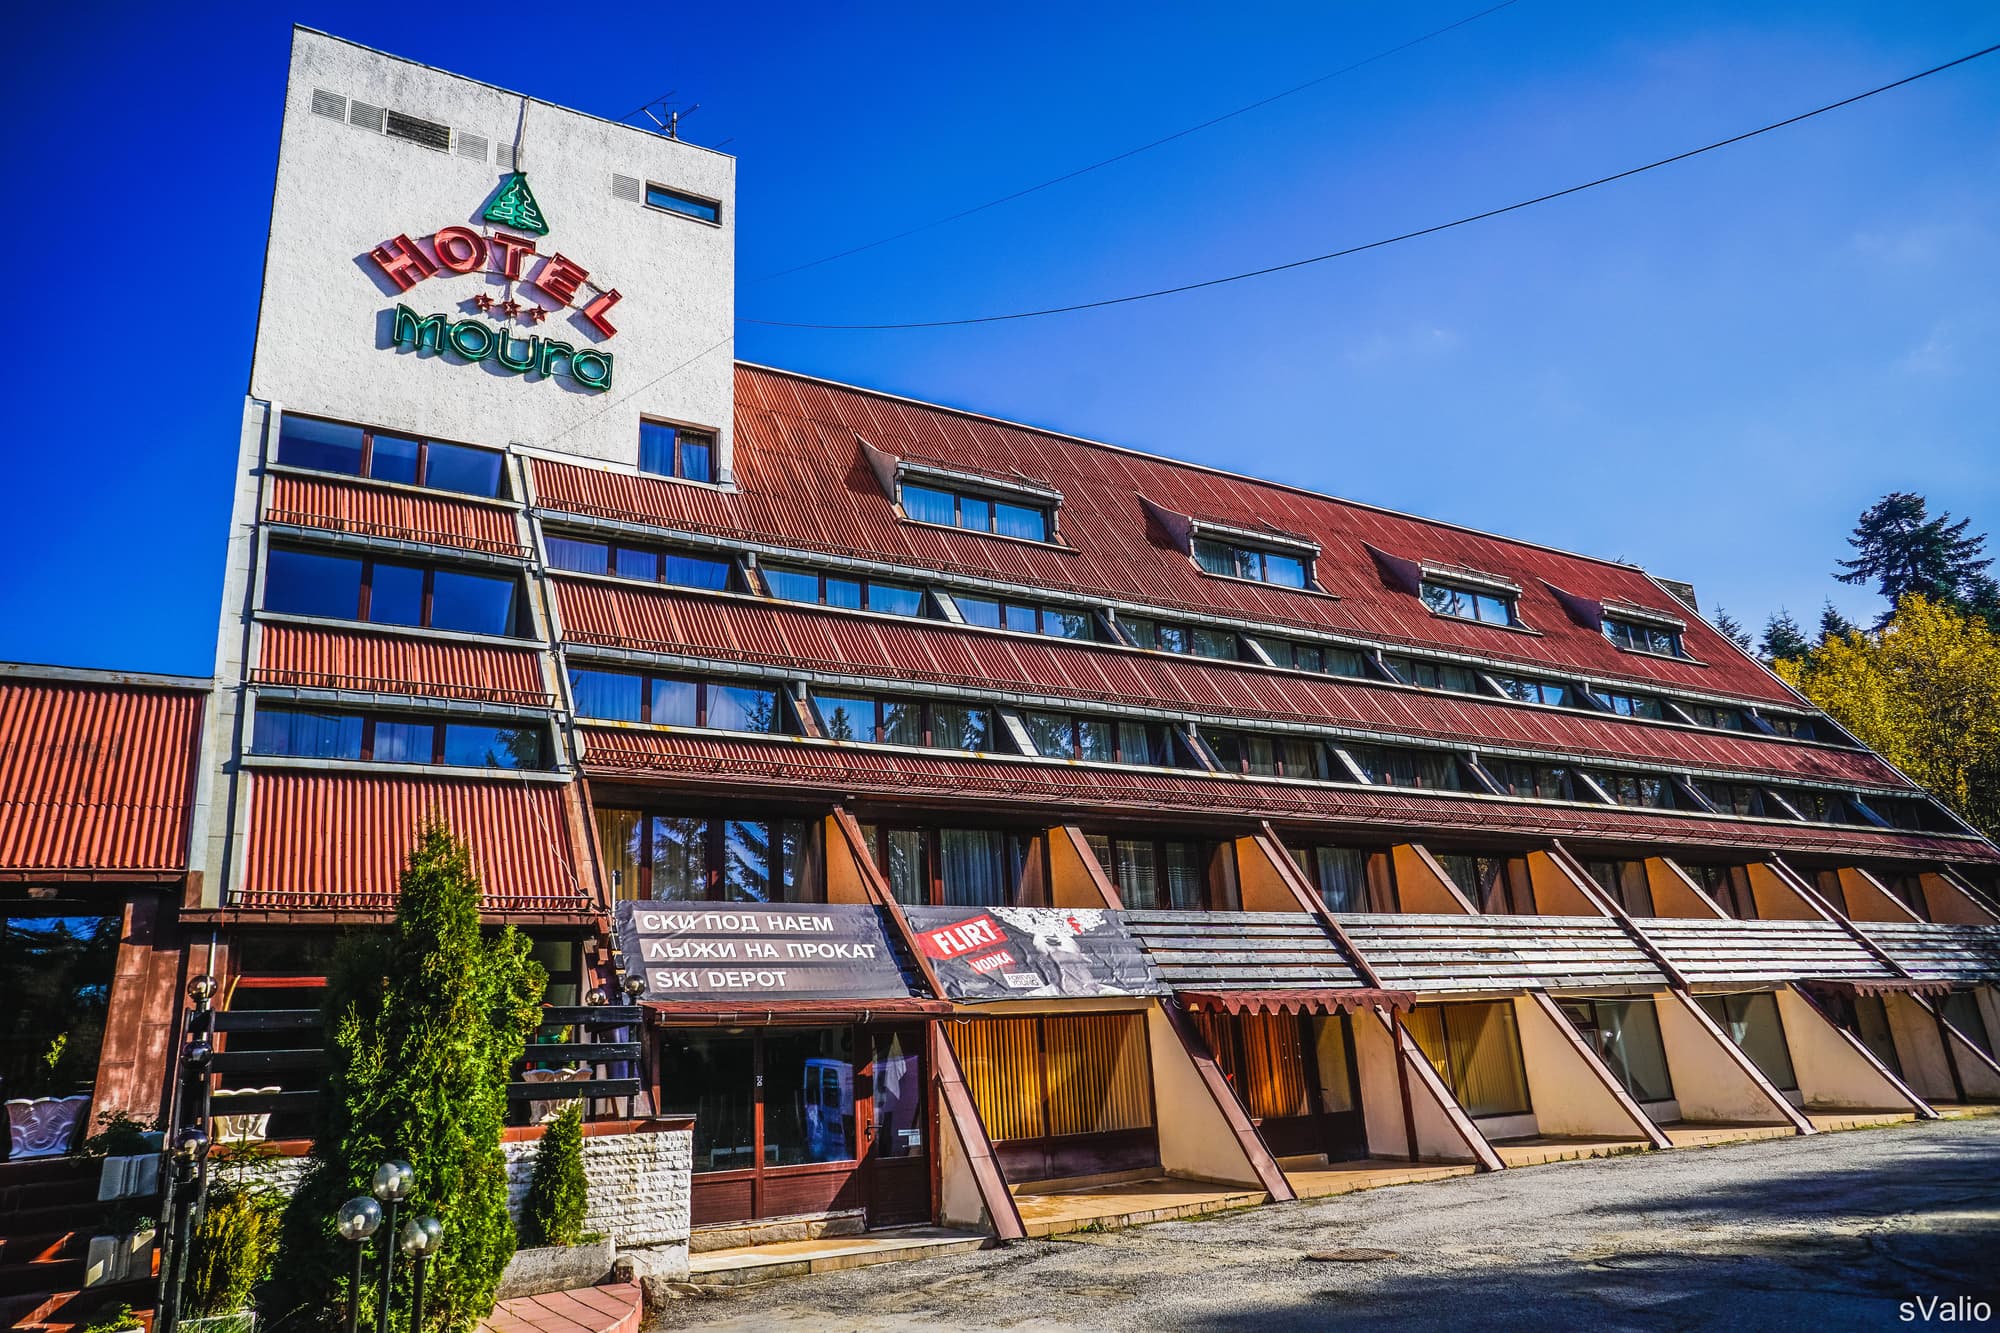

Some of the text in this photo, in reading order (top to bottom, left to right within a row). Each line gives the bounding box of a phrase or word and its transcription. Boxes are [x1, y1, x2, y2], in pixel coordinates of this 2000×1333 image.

[369, 225, 623, 340] HOTEL
[642, 914, 834, 932] СКИ ПОД НАЕМ
[932, 918, 998, 955] FLIRT
[650, 942, 876, 959] ЛЫЖИ НА ПРОКАТ
[971, 951, 1014, 973] VODKA
[656, 971, 787, 988] SKI DEPOT
